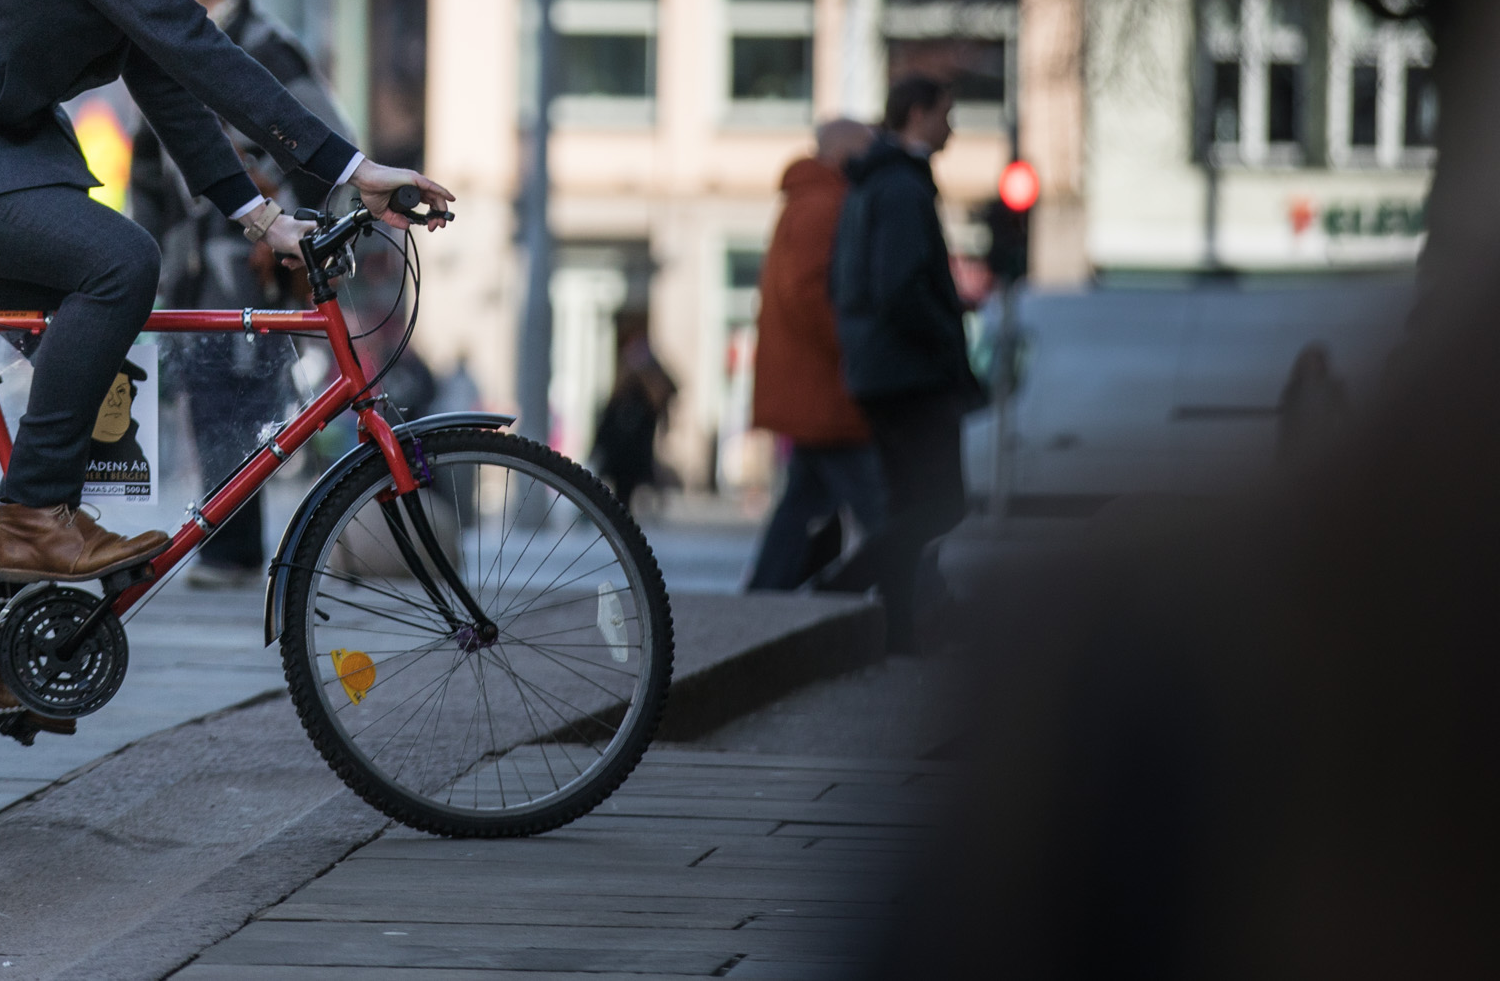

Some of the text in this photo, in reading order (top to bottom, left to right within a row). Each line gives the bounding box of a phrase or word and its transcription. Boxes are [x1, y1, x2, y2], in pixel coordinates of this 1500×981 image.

[86, 460, 148, 471] ÅDENS ÅR
[110, 471, 148, 480] BERGEN
[126, 486, 140, 494] 500
